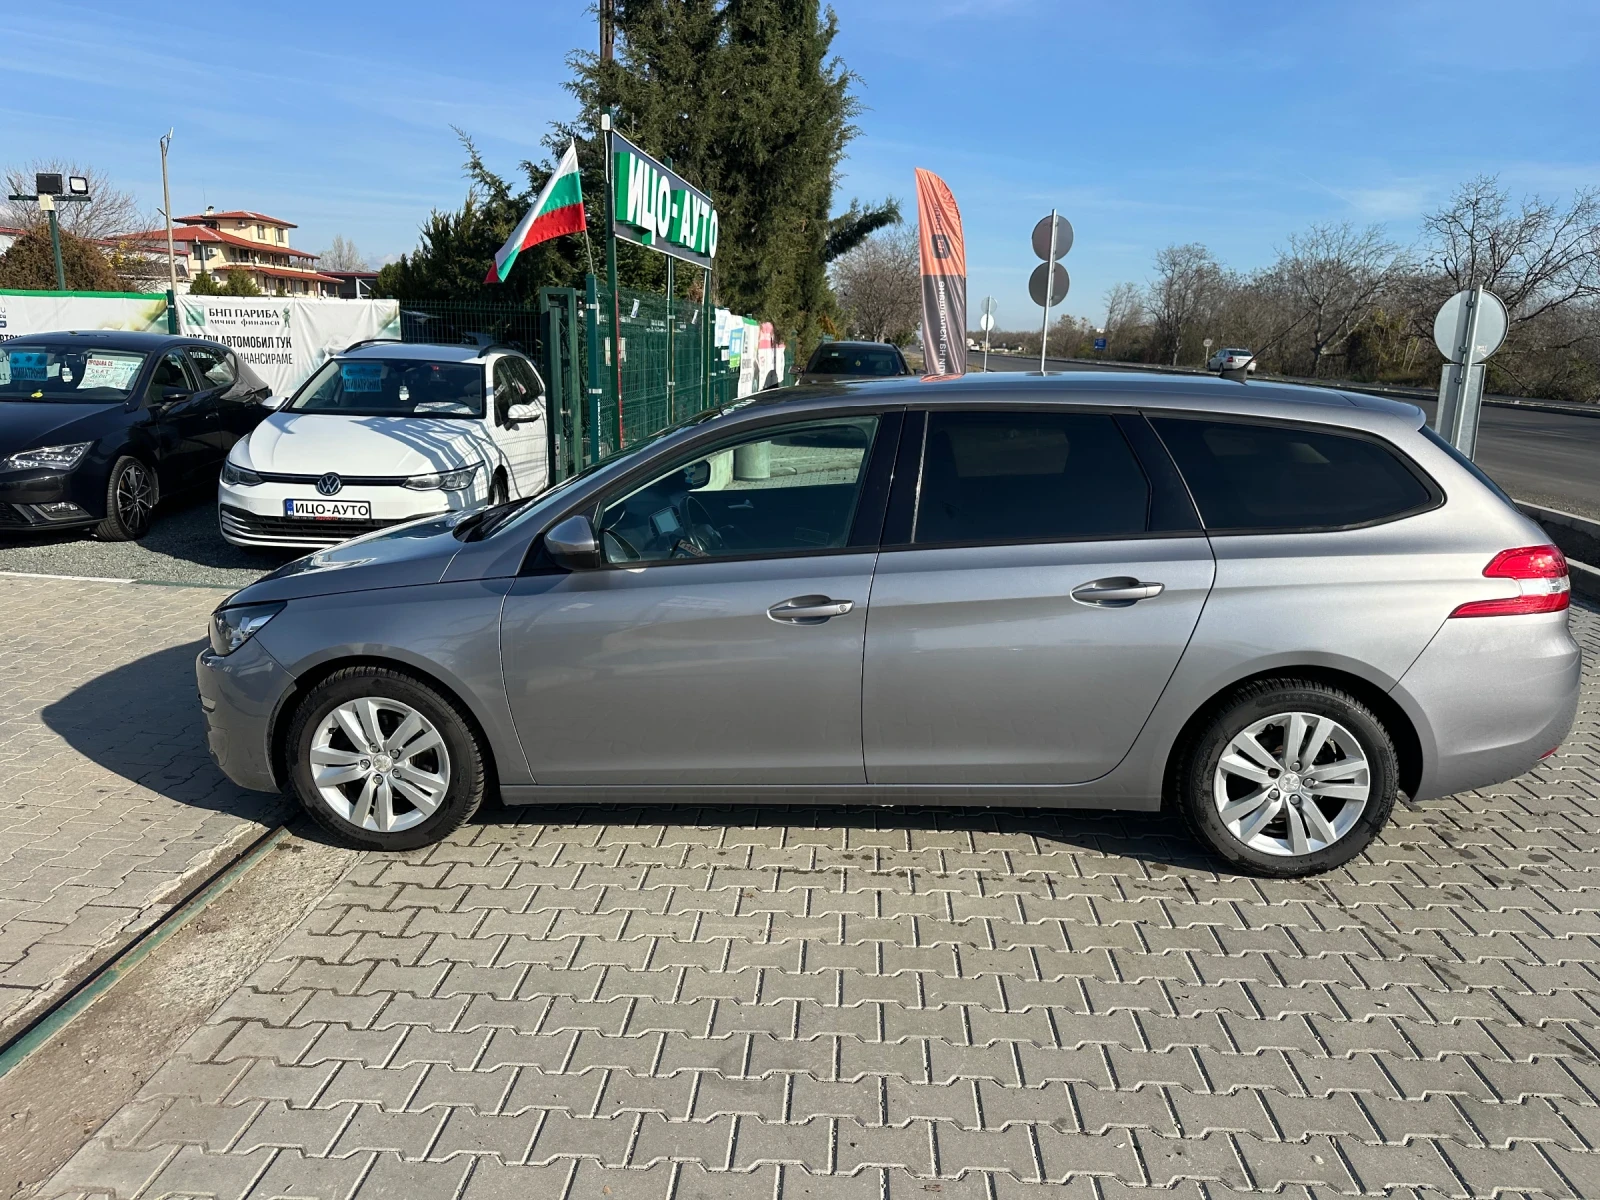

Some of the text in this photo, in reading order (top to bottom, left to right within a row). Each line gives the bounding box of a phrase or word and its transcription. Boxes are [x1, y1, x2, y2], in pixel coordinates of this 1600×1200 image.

[627, 152, 718, 258] ИЦО-АУТО
[209, 308, 279, 318] БНП ПАРИБА
[240, 318, 280, 327] финанси
[221, 335, 274, 348] АВТОМОБИЛ
[276, 336, 292, 348] ТУК
[295, 503, 368, 516] ИЦО-АУТО
